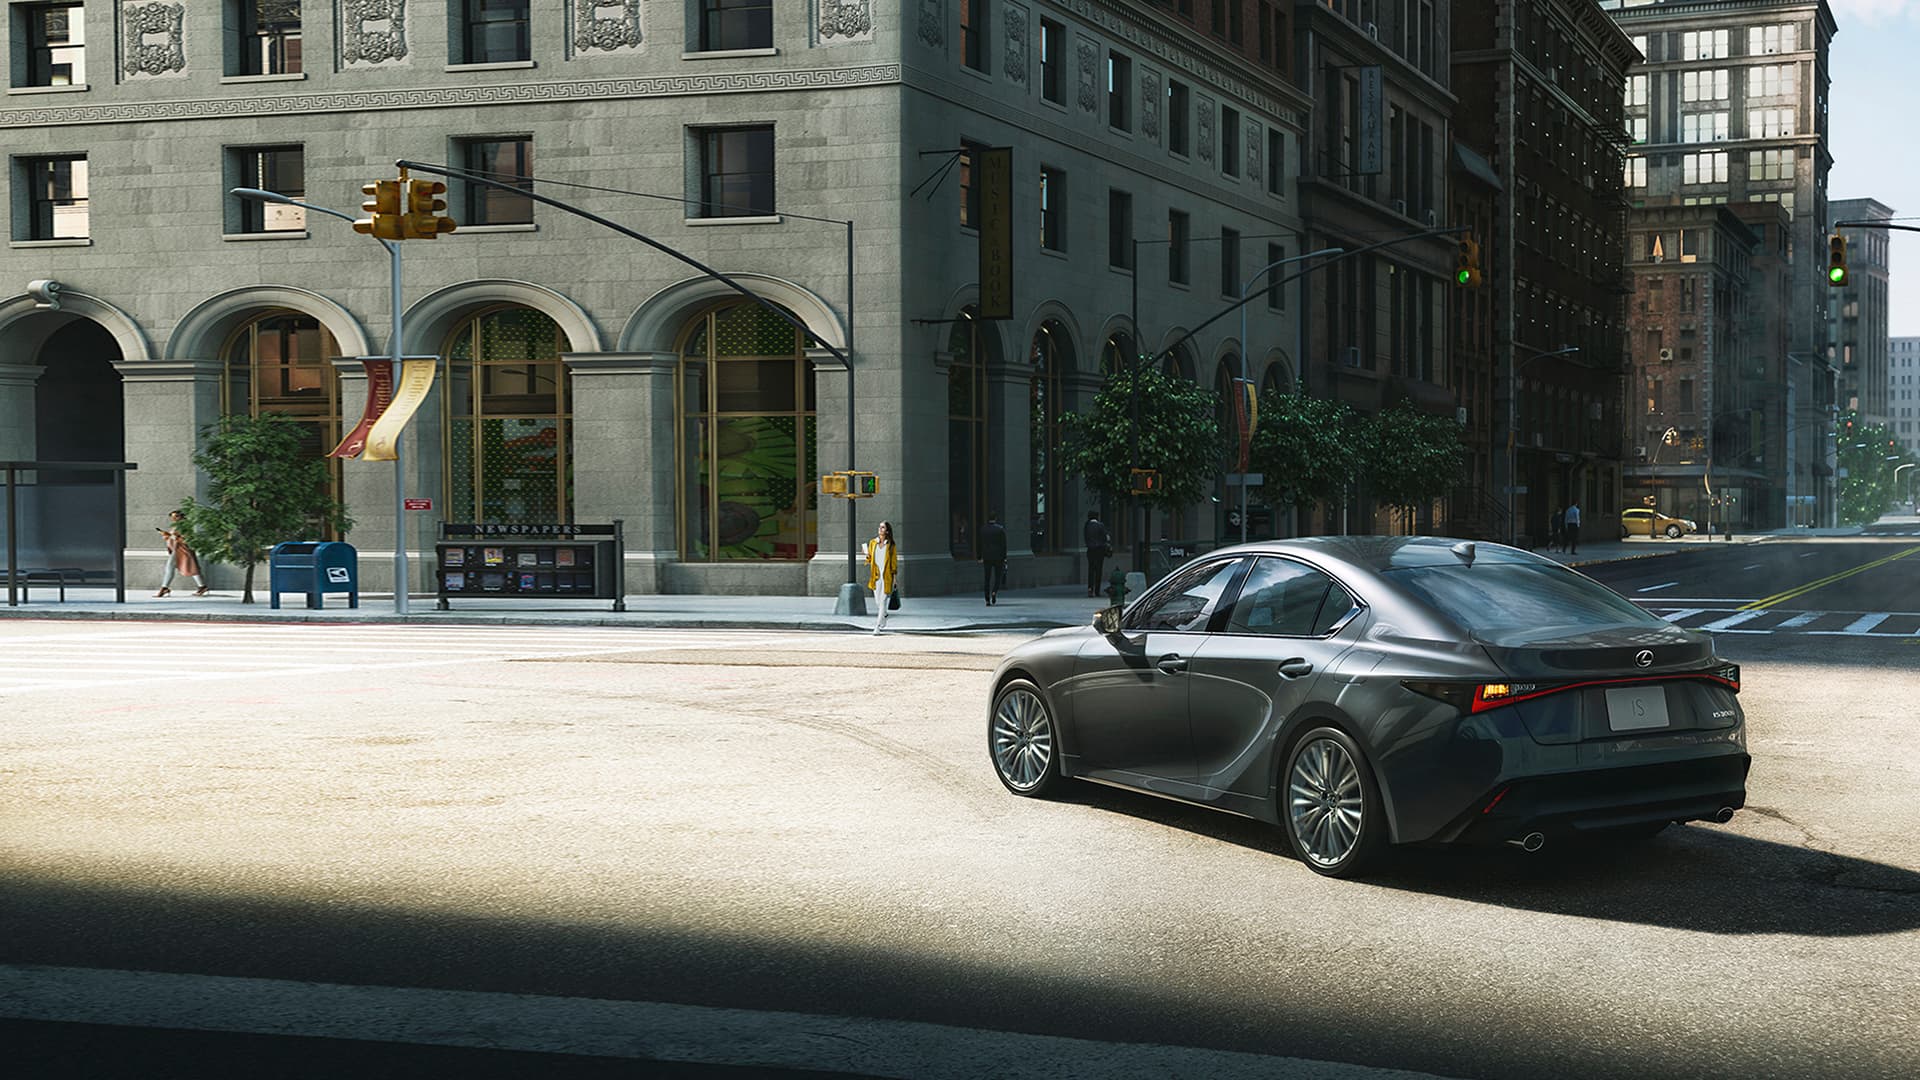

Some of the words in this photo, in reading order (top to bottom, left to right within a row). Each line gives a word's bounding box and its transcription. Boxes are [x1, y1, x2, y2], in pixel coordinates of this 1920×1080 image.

[1367, 70, 1377, 169] RESTAURANT
[990, 156, 1001, 231] MUSIC
[990, 247, 1001, 307] BOOK
[474, 525, 582, 534] NEWSPAPERS
[1631, 698, 1646, 717] IS
